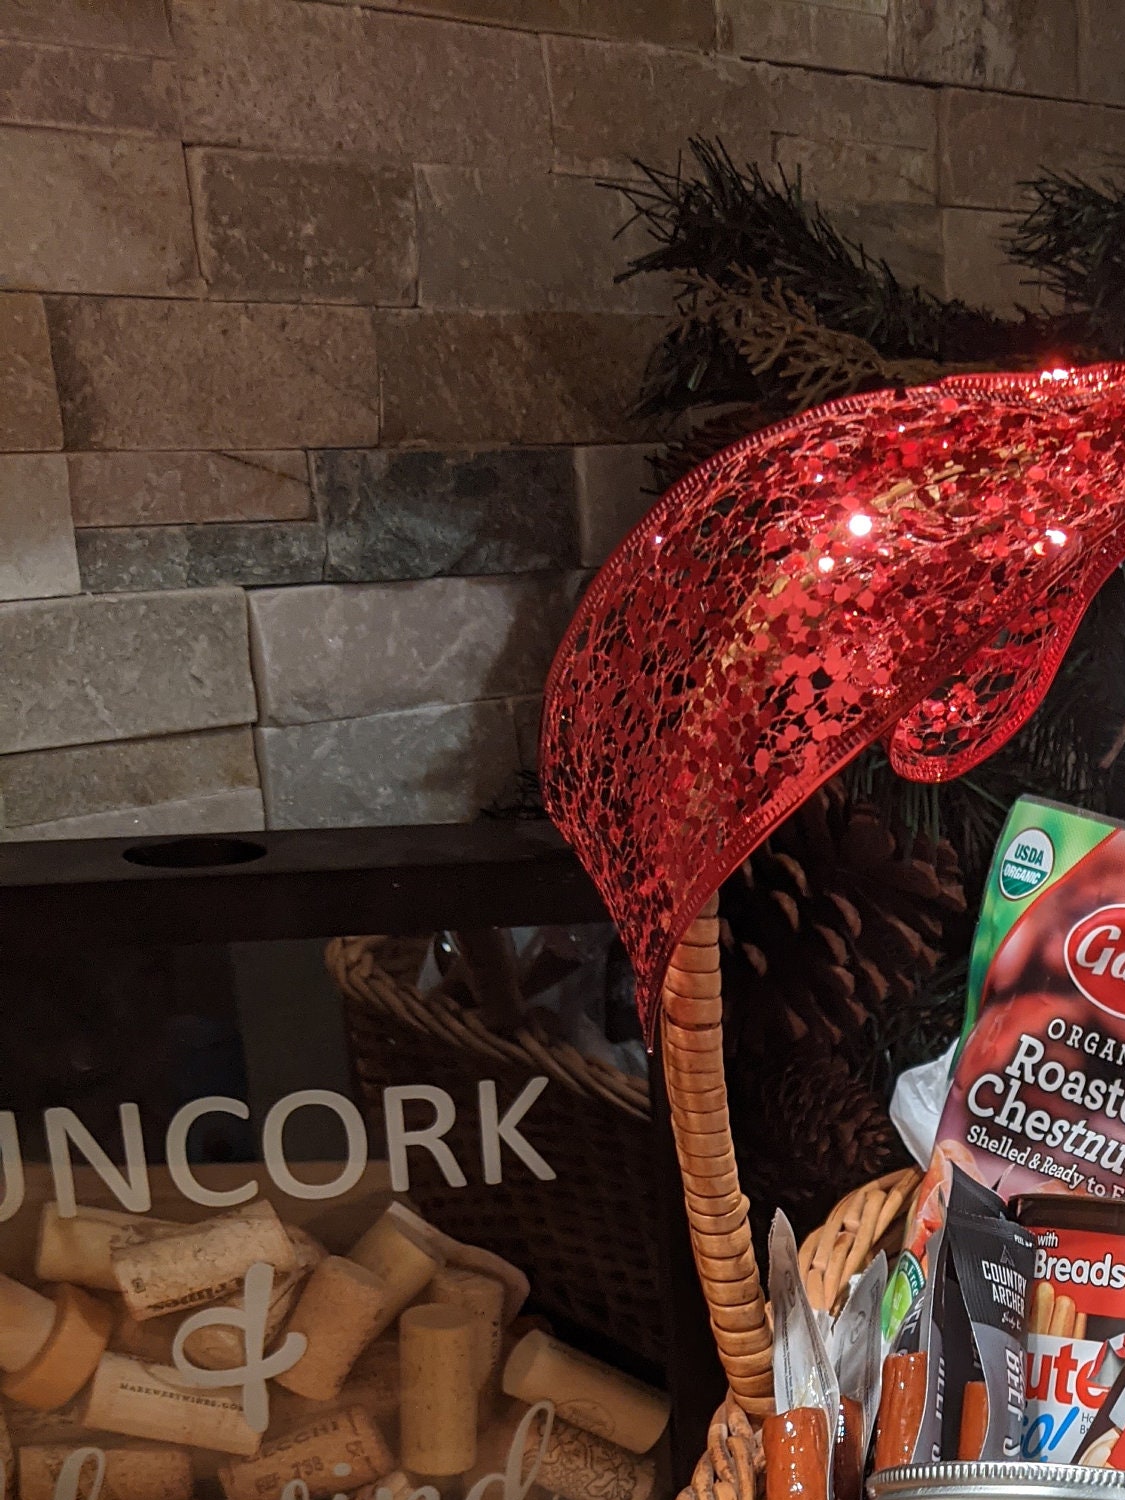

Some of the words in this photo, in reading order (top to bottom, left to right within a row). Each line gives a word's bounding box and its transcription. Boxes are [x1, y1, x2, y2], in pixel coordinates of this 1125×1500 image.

[1013, 843, 1045, 867] USDA
[1003, 862, 1042, 886] ORGANIC
[966, 1124, 1032, 1166] Shelled
[1028, 1152, 1041, 1170] &
[1039, 1156, 1086, 1190] Ready
[1087, 1176, 1107, 1196] to
[1037, 1230, 1060, 1249] with
[981, 1259, 1028, 1298] COUNTRY
[991, 1282, 1026, 1320] ARCHER
